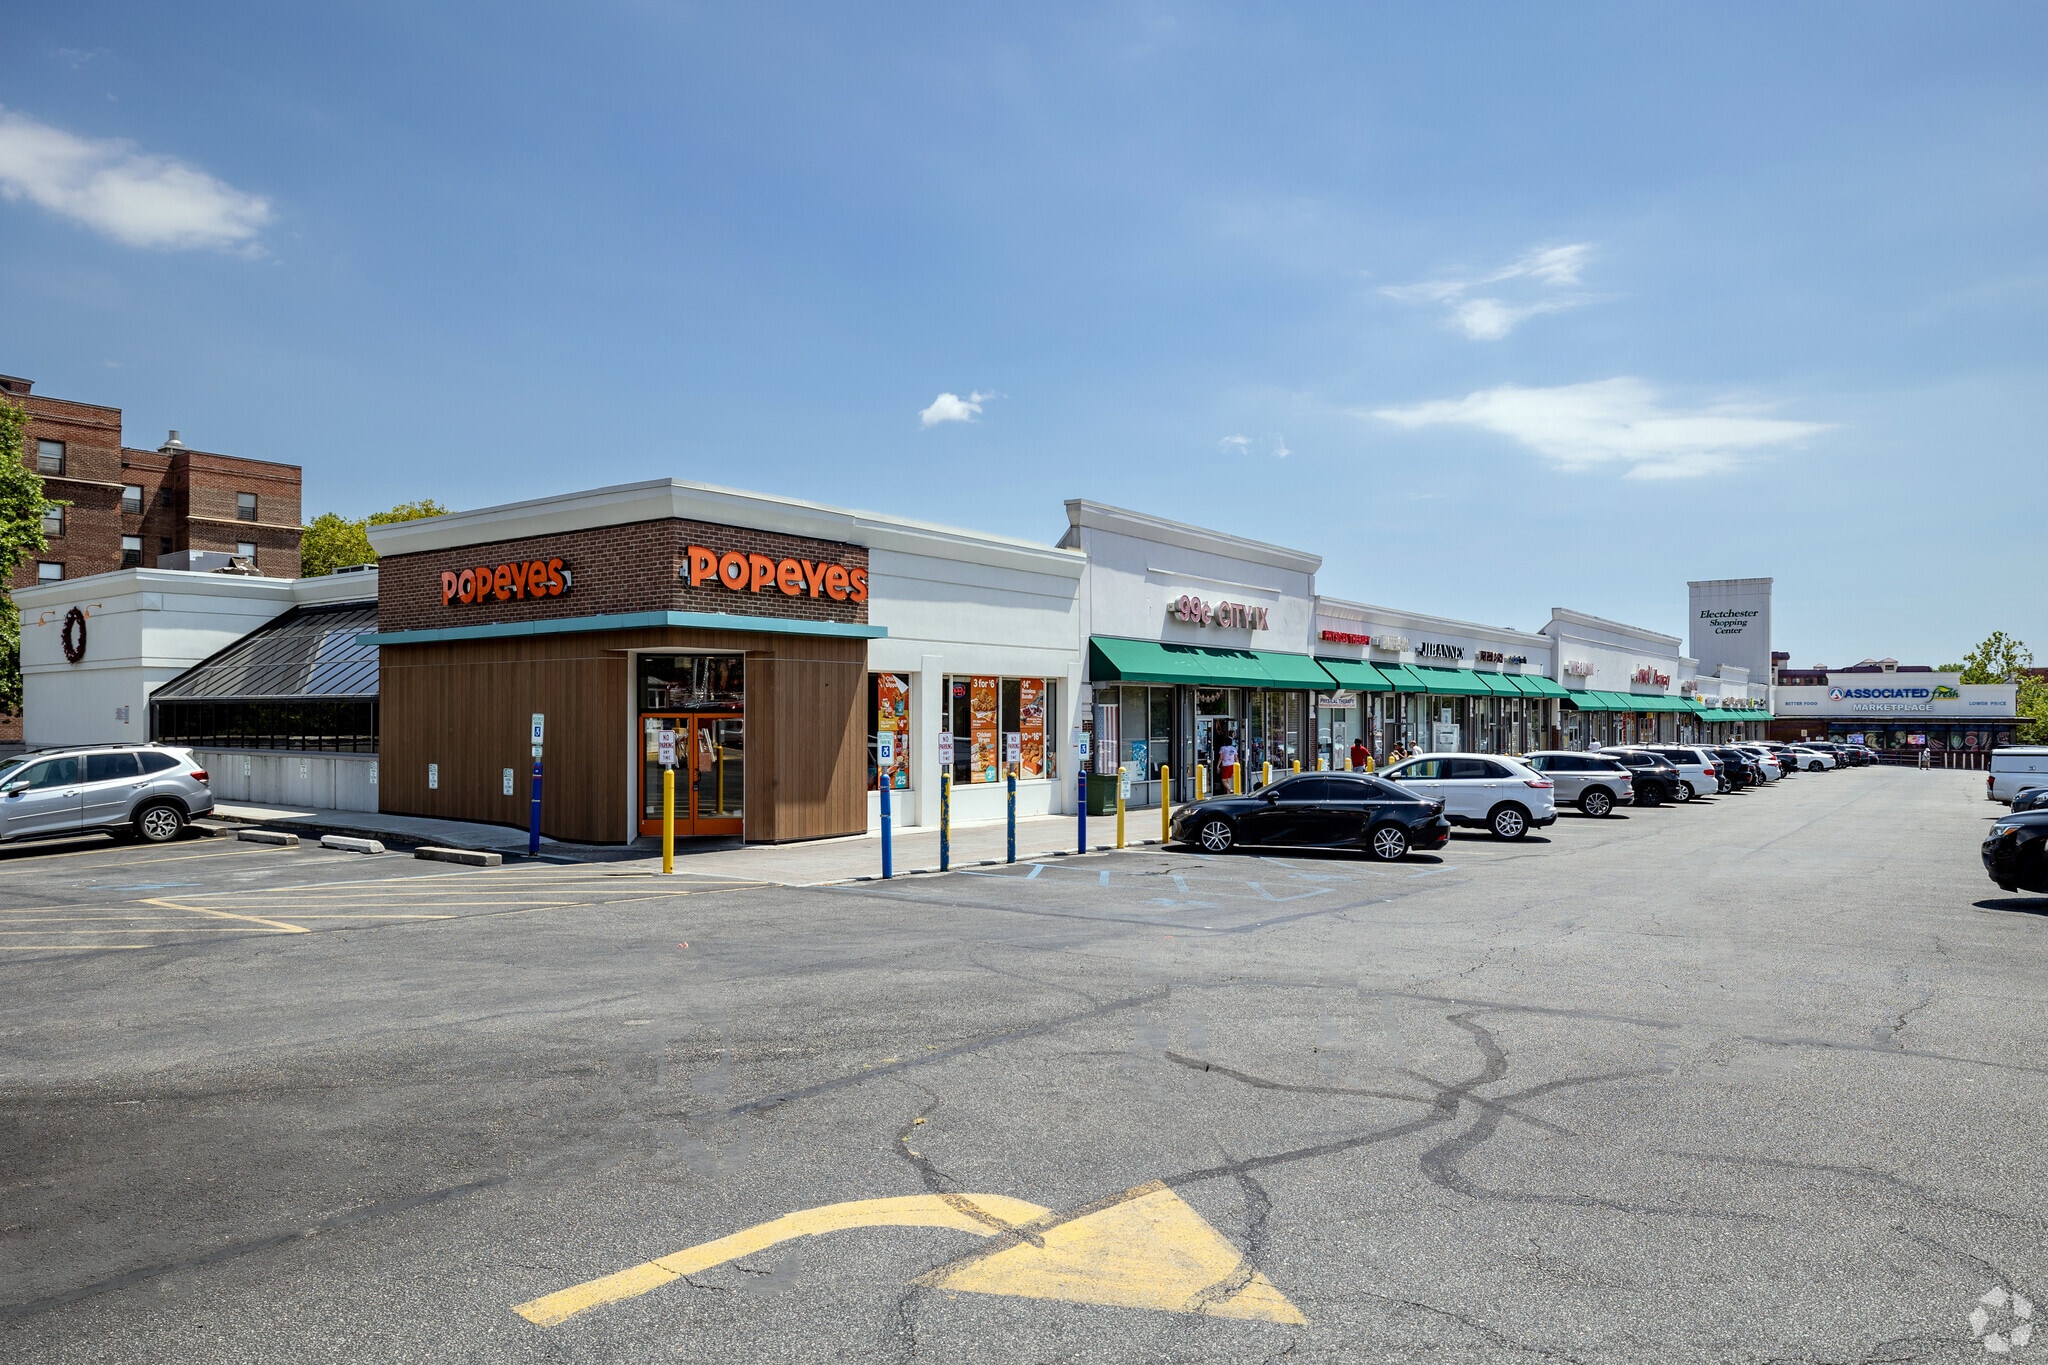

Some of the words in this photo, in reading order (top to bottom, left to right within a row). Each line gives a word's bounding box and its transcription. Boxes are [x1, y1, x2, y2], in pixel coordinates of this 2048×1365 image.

[1218, 600, 1252, 628] CITY
[1700, 609, 1759, 619] Electchester
[1710, 619, 1748, 627] Shopping
[973, 678, 978, 687] 3
[978, 679, 988, 688] for
[1844, 688, 1930, 699] ASSOCIATED
[1928, 685, 1961, 703] fresh
[1853, 703, 1933, 711] MARKETPLACE
